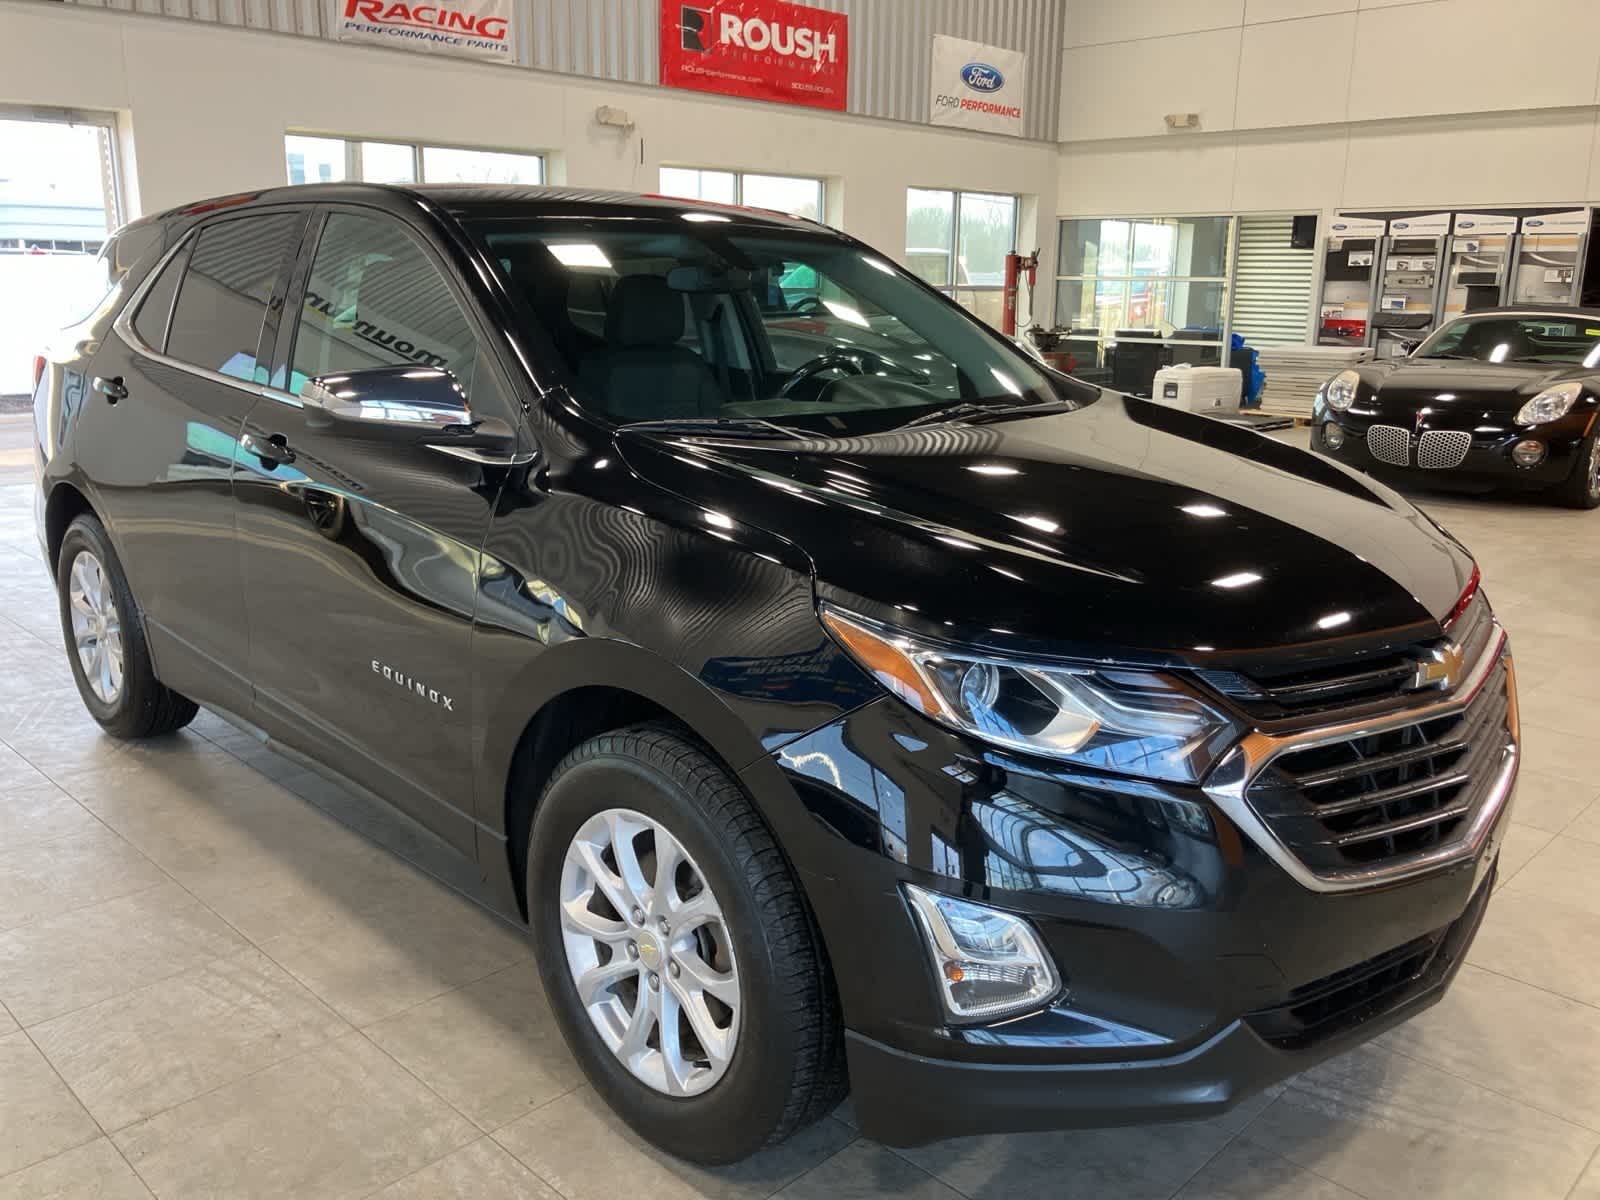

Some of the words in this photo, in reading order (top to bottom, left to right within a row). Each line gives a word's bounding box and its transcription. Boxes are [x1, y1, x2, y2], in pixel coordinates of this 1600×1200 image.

[344, 0, 509, 40] RACING
[344, 21, 463, 45] PERFORMANCE
[466, 40, 509, 52] PARTS
[720, 13, 837, 63] ROUSH
[966, 65, 998, 89] Ford
[935, 95, 959, 108] FORD
[960, 98, 1022, 118] PERFORMANCE
[371, 659, 453, 711] EQUINOX
